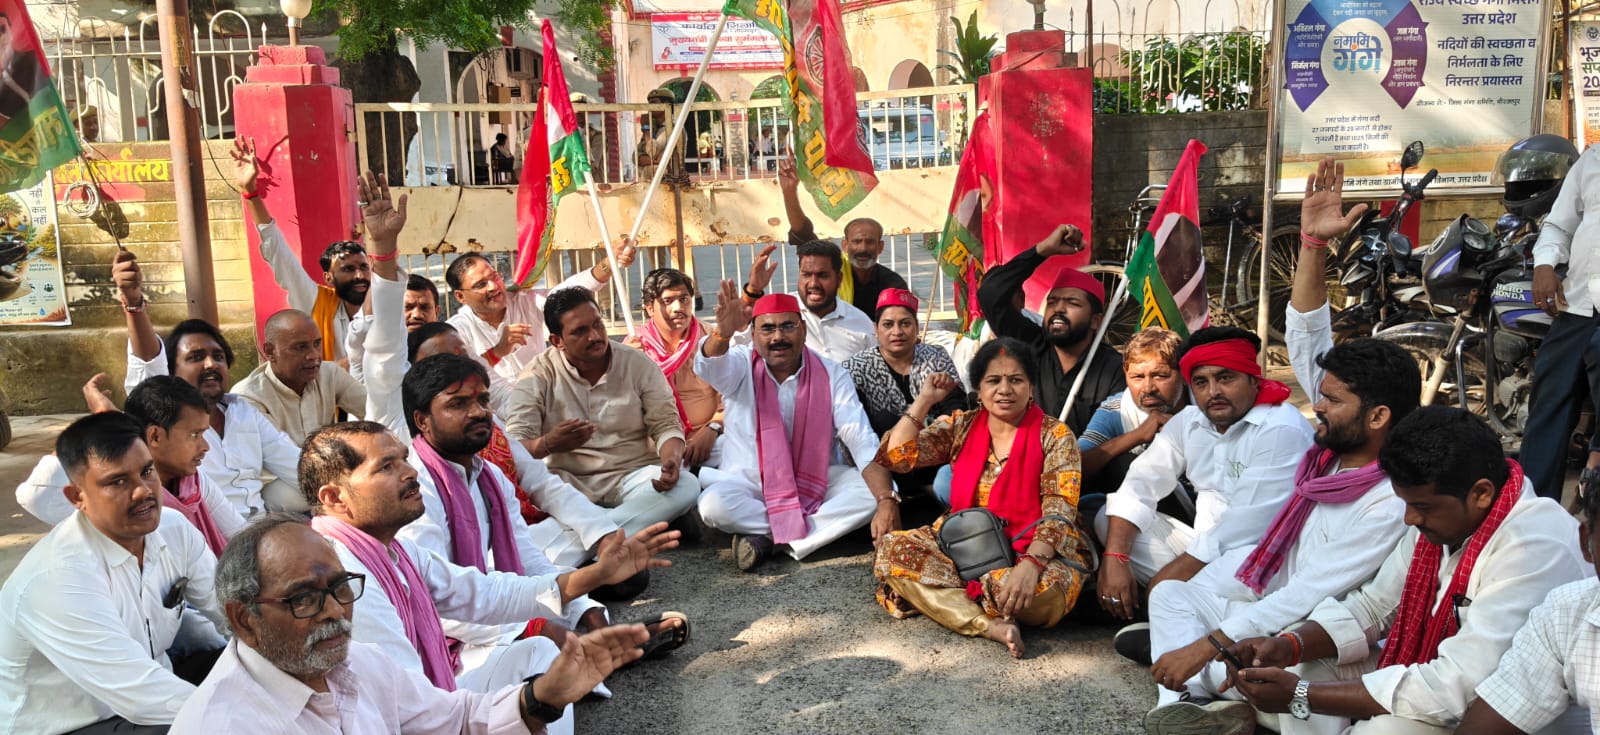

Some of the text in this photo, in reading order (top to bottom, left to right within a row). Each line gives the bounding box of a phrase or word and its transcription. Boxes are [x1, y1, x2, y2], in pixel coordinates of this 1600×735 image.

[1462, 10, 1516, 25] उत्तर प्रदेश
[1333, 32, 1370, 47] नमामि
[1437, 36, 1537, 50] नदियों की स्वच्छता व
[1332, 38, 1383, 74] गंगे
[1448, 54, 1523, 68] निर्मलता के लिए
[1445, 74, 1523, 87] निरन्तर प्रयासरत
[1472, 174, 1488, 183] प्रदेश
[1491, 289, 1527, 301] HONDA
[1496, 283, 1523, 293] HERO
